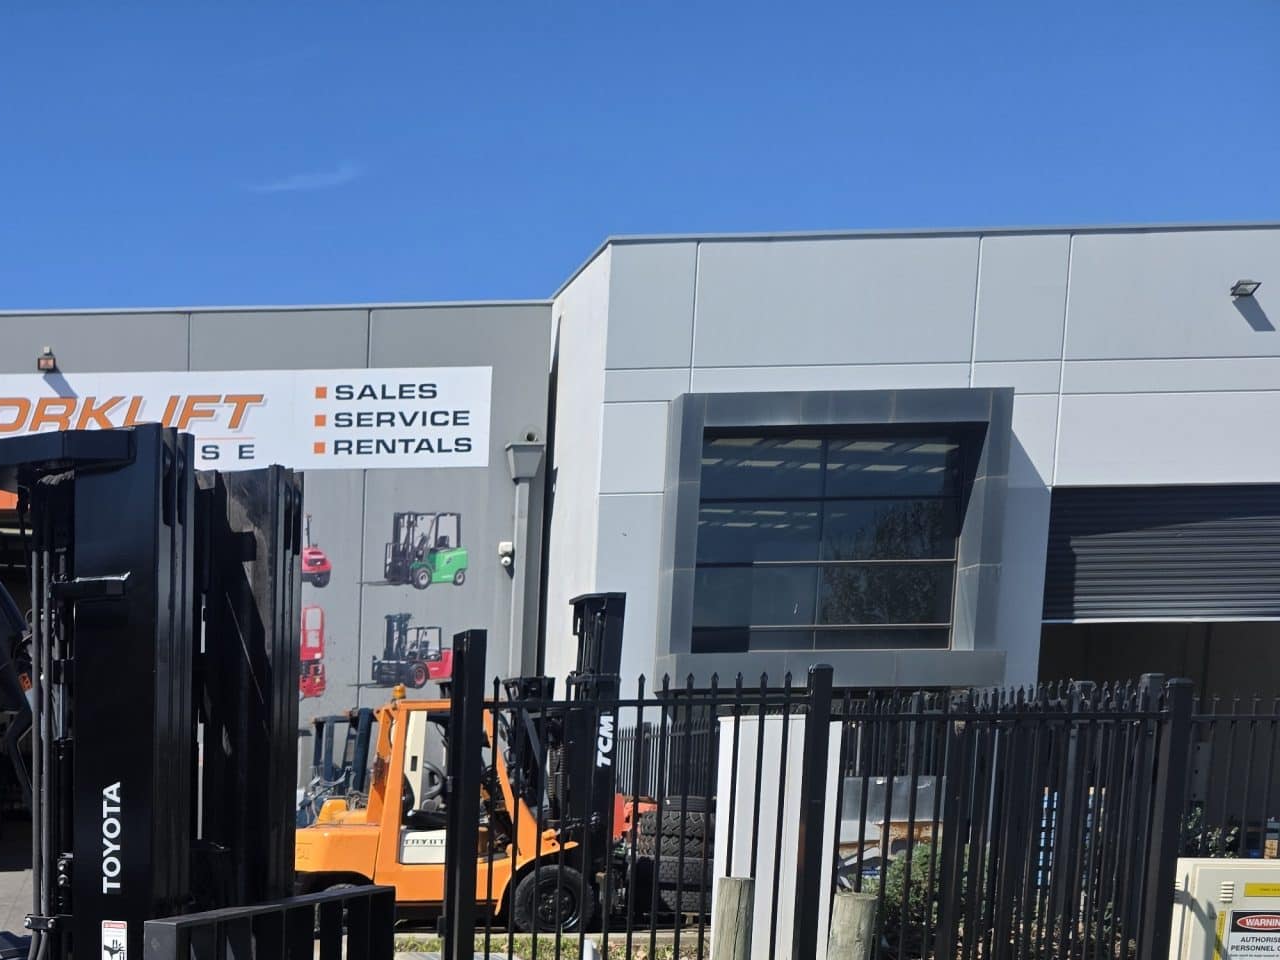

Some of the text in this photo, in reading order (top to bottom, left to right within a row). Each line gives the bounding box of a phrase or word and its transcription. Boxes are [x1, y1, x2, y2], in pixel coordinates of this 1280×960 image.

[335, 383, 438, 401] SALES
[334, 410, 471, 428] SERVICE
[333, 437, 473, 455] RENTALS
[596, 715, 614, 768] TCM
[102, 781, 121, 894] TOYOTA
[1230, 944, 1275, 952] PERSONNEL
